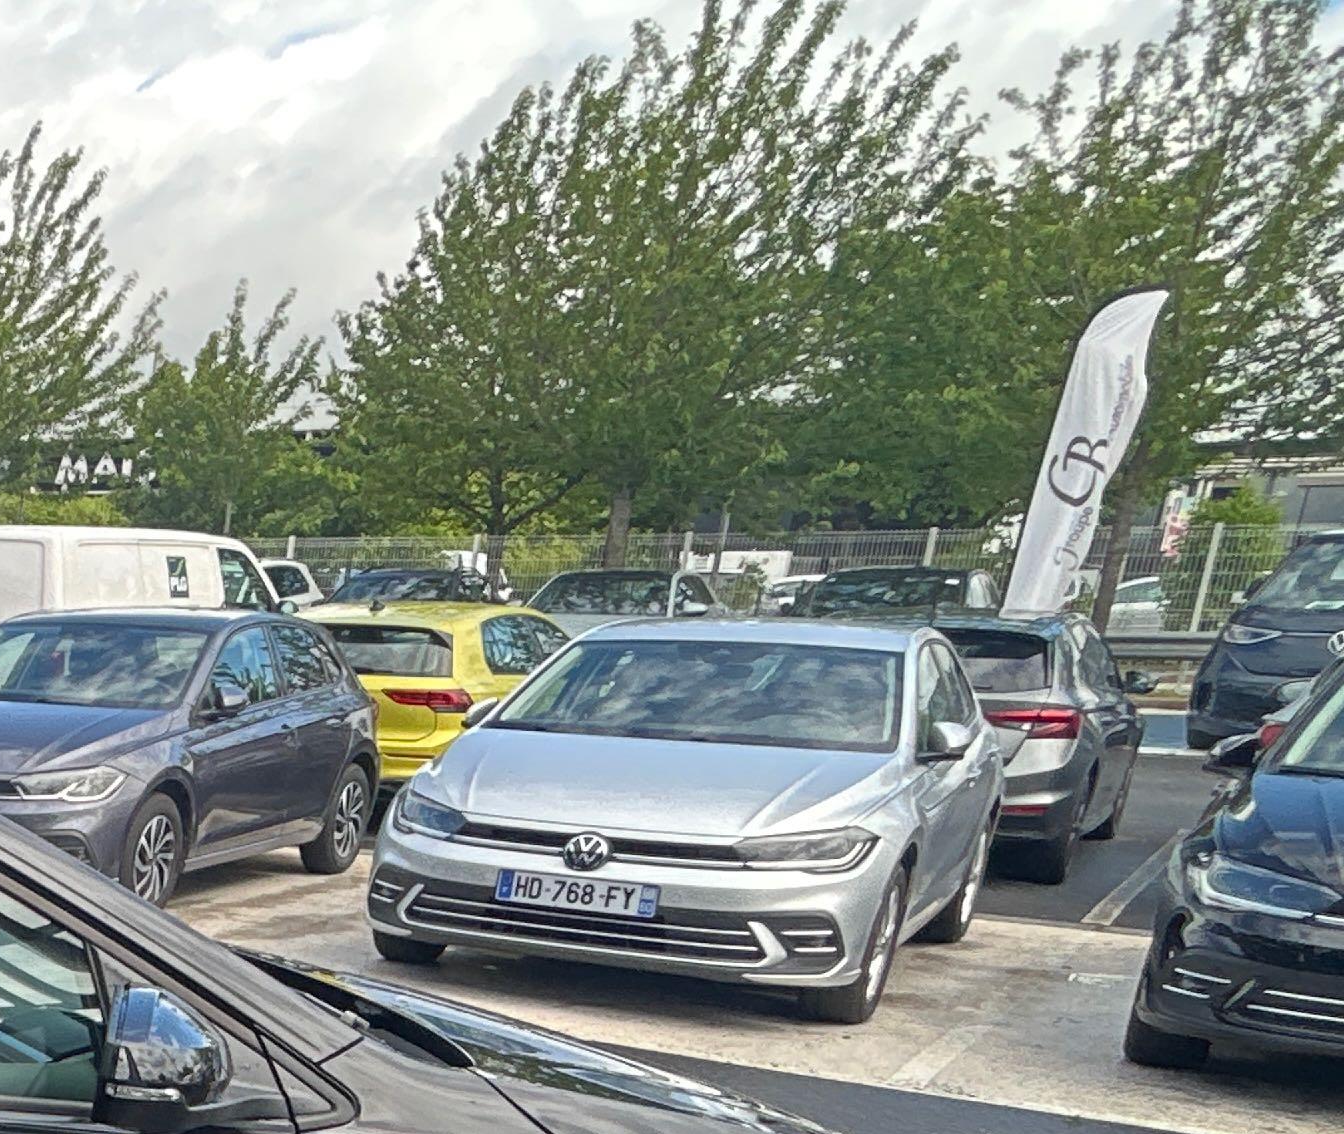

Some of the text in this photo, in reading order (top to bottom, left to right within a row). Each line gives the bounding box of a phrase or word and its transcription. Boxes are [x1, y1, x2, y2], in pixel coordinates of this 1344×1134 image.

[1048, 436, 1109, 507] CR
[170, 576, 188, 591] PLG
[514, 875, 636, 910] HD-768-FY
